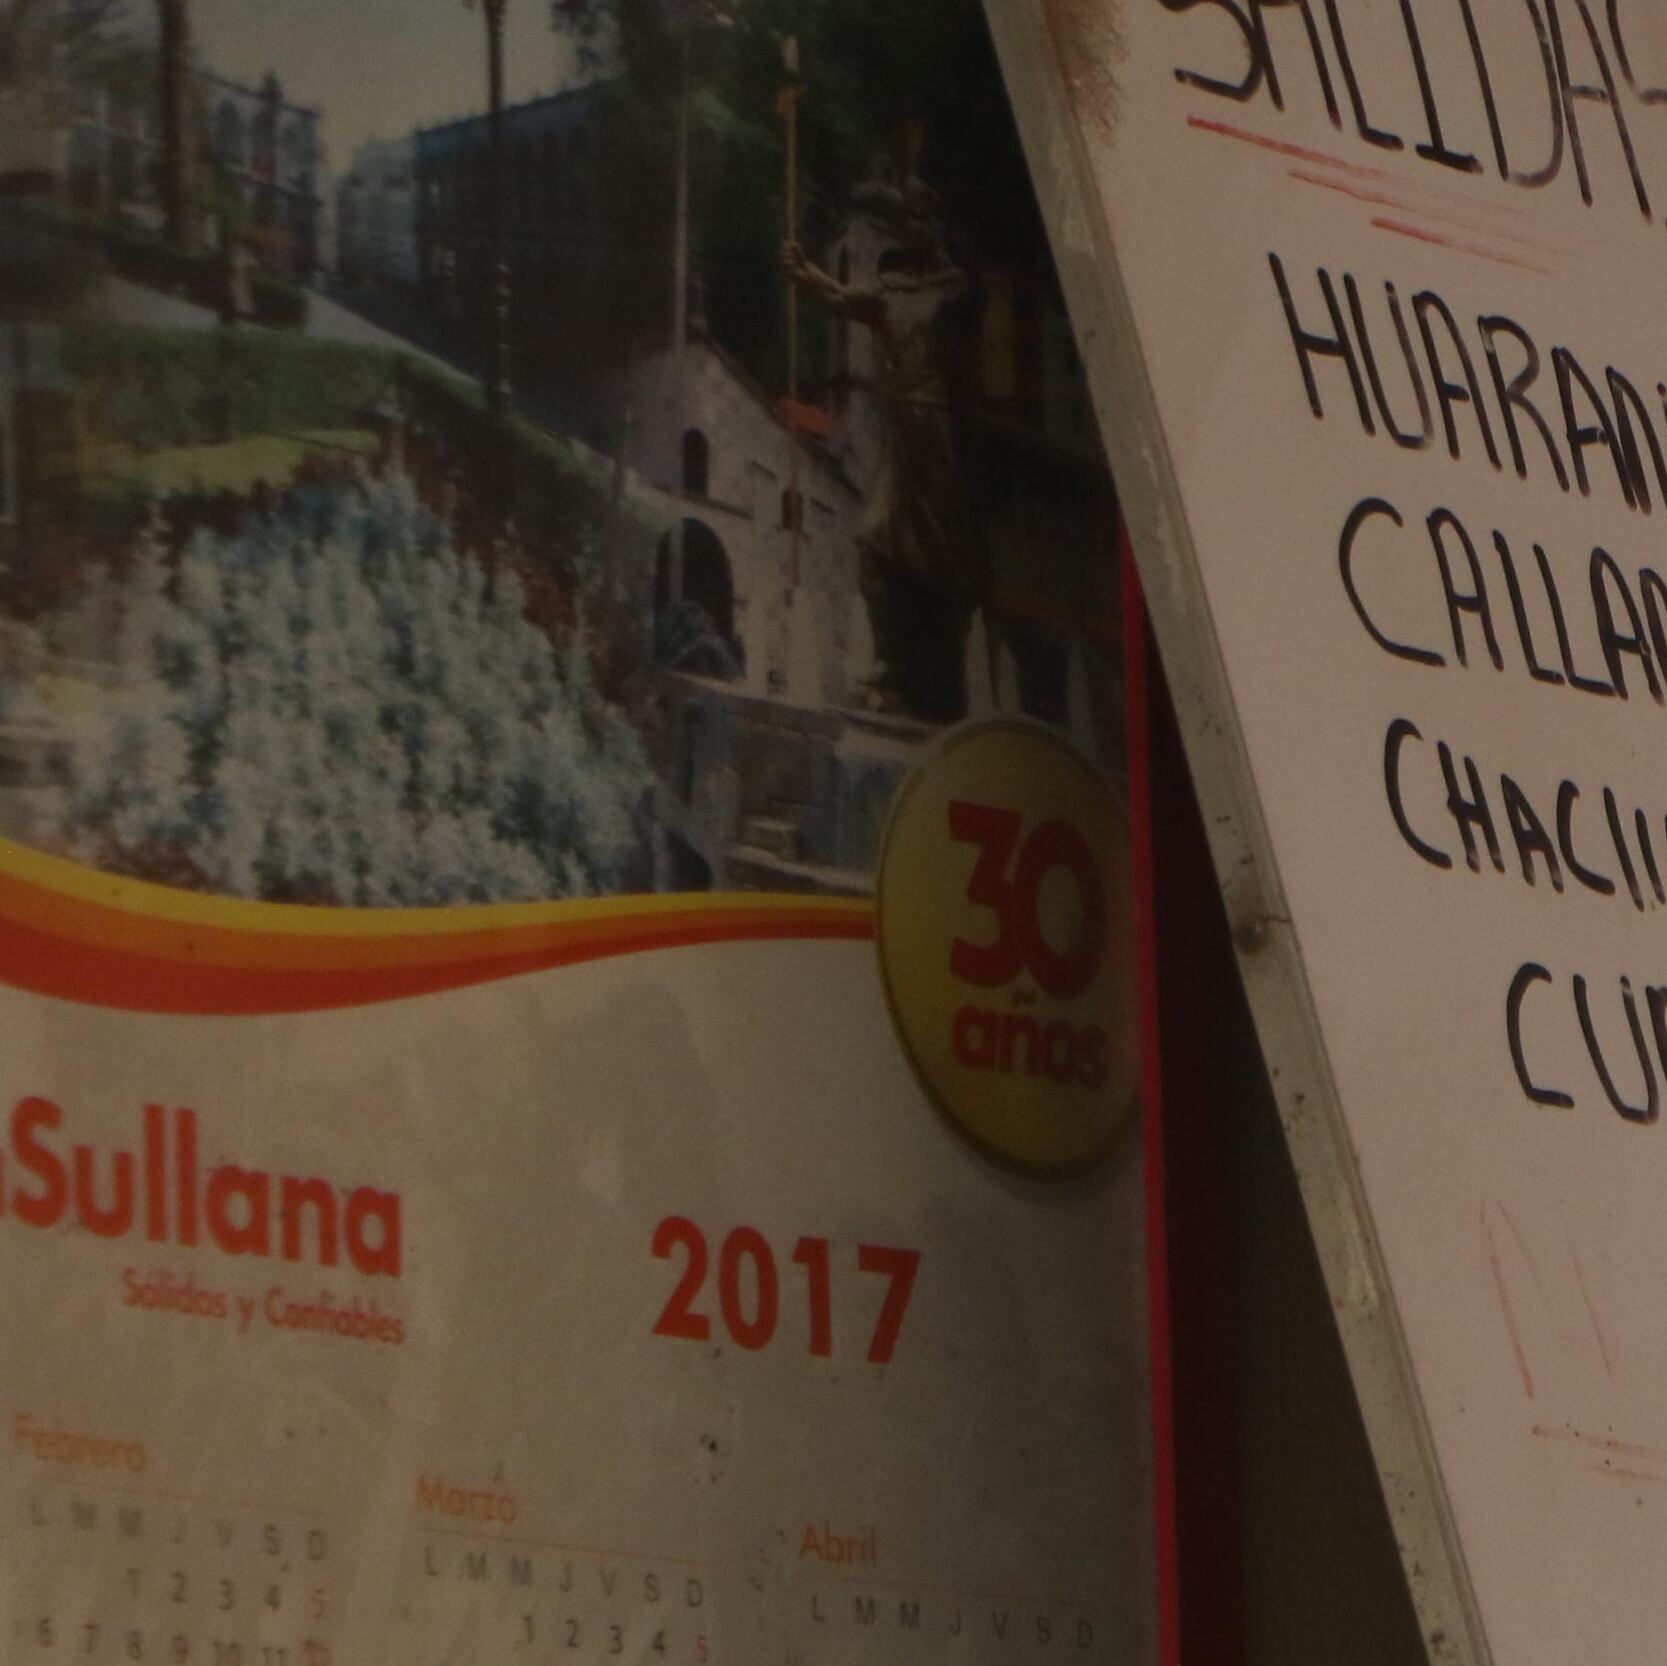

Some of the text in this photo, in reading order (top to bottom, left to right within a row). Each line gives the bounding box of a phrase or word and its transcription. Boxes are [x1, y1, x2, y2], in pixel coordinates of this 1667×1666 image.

[946, 800, 1107, 1001] 30
[950, 988, 1110, 1089] años
[0, 1095, 402, 1278] Sullana
[648, 1213, 922, 1366] 2017
[415, 1472, 520, 1525] Marzo
[799, 1520, 879, 1569] Abril
